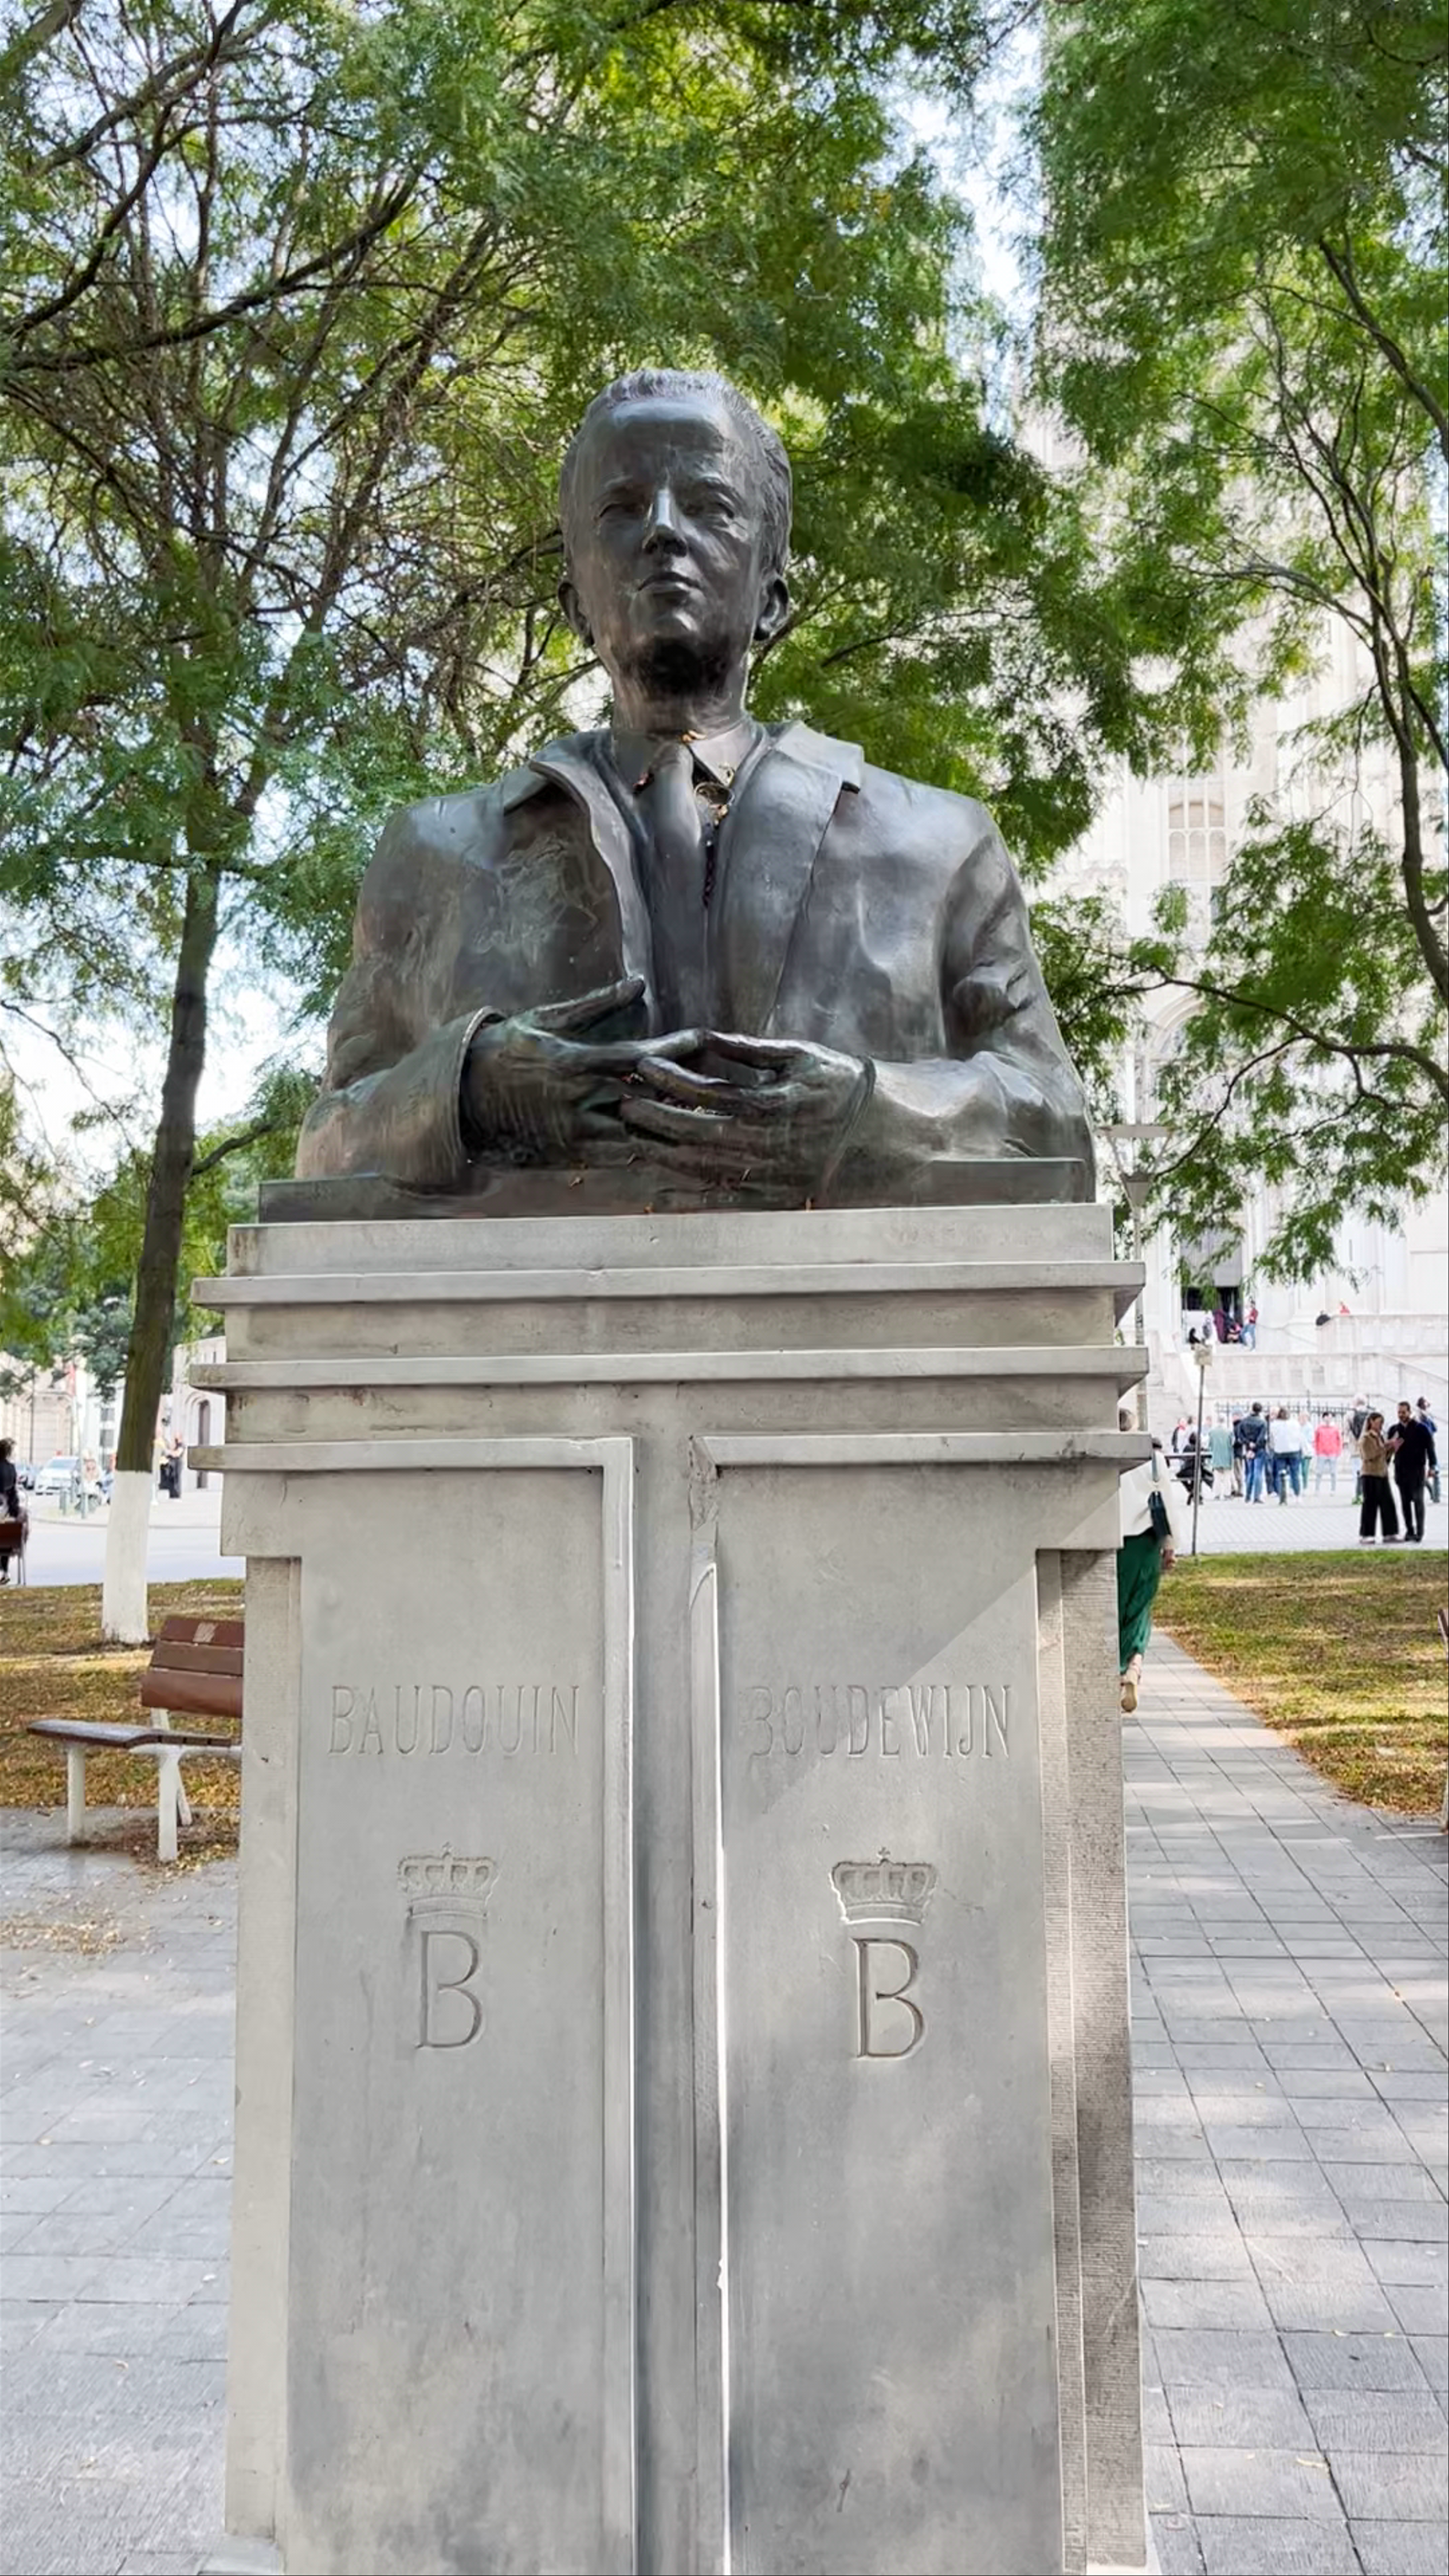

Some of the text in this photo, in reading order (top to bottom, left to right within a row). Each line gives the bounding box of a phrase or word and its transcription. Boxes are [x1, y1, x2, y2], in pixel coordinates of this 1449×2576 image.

[328, 1685, 580, 1755] BAUDOUIN
[749, 1684, 1012, 1758] BOUDEWIJN
[414, 1930, 483, 2050] B
[851, 1937, 925, 2060] B
